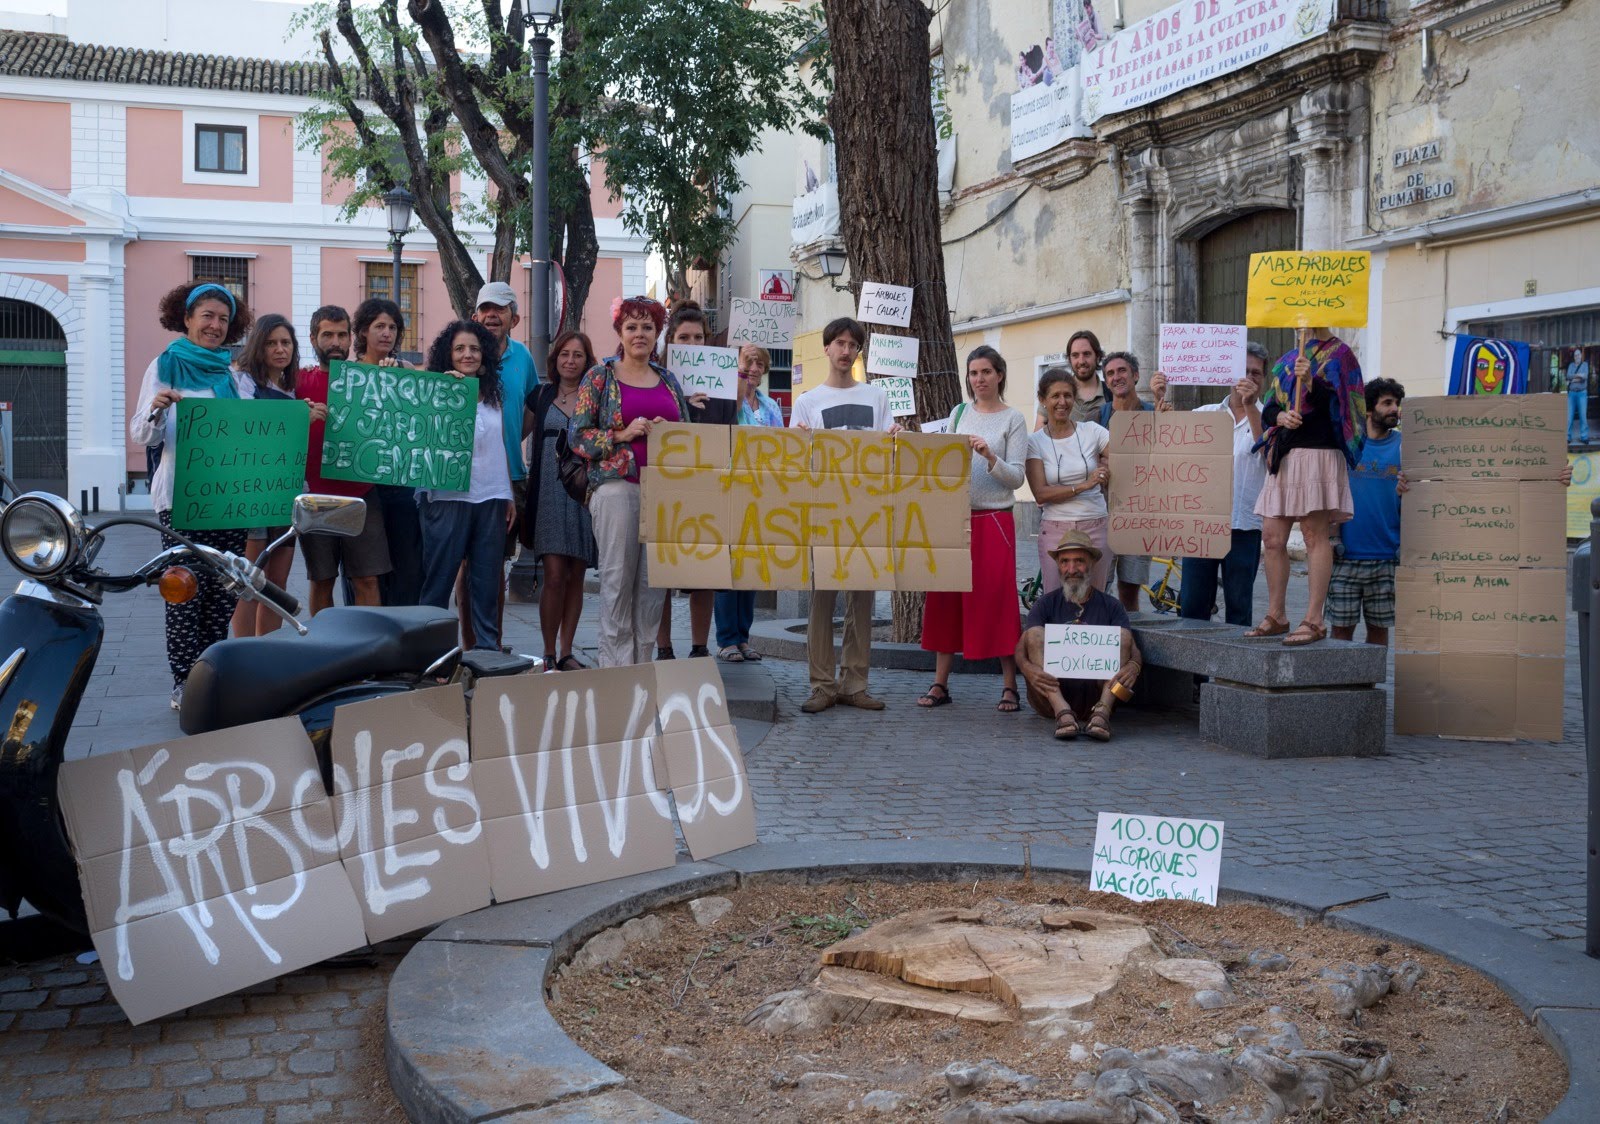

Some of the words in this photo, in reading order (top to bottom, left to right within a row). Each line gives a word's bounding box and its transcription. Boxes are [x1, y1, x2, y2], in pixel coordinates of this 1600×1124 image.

[1086, 72, 1102, 87] EN
[1108, 49, 1162, 81] DEFENSA
[1166, 38, 1182, 56] DE
[1187, 27, 1204, 47] LA
[1209, 1, 1279, 37] CULTURA
[1096, 40, 1119, 69] 17
[1129, 9, 1181, 53] AÑOS
[1194, 0, 1221, 24] DE
[1112, 81, 1128, 97] DE
[1130, 70, 1153, 91] LAS
[1155, 53, 1193, 81] CASAS
[1197, 46, 1214, 63] DE
[1217, 13, 1287, 54] VECINDAD
[1175, 72, 1197, 88] CASA
[1199, 65, 1216, 77] DEL
[1218, 42, 1270, 72] PUMAREJO
[1394, 144, 1438, 166] PLAZA
[1407, 173, 1424, 187] DE
[1379, 182, 1452, 209] PUMAREJO
[1253, 255, 1294, 279] MAS
[1296, 255, 1366, 273] ARBOLES
[1271, 275, 1307, 286] CON
[1311, 273, 1353, 287] HOJAS
[732, 299, 767, 316] PODA
[770, 302, 796, 318] CUTRE
[1283, 295, 1345, 308] COCHES
[748, 318, 778, 329] MATA
[1163, 326, 1187, 336] PARA
[1192, 326, 1205, 334] NO
[1210, 327, 1239, 335] TALAR
[733, 324, 789, 344] ÁRBOLES
[1163, 341, 1178, 350] HAY
[1182, 340, 1197, 349] QUE
[1201, 340, 1239, 348] CUIDAR
[671, 349, 705, 366] MALA
[709, 352, 739, 370] PODA
[1162, 354, 1174, 362] LOS
[682, 374, 724, 389] MATA
[888, 378, 912, 388] PODA
[245, 420, 287, 437] UNA
[329, 405, 351, 433] Y
[357, 408, 475, 447] JARDINES
[1121, 413, 1214, 447] ÁRBOLES
[321, 440, 355, 468] DE
[656, 430, 714, 479] EL
[1490, 445, 1506, 453] UN
[1511, 440, 1548, 453] ÁRBOL
[1433, 458, 1472, 468] ANTES
[1477, 458, 1495, 467] DE
[1135, 461, 1209, 487] BANCOS
[1471, 470, 1501, 478] OTRO
[186, 502, 210, 522] DE
[1492, 505, 1512, 515] EN
[1111, 516, 1184, 532] QUEREMOS
[1193, 519, 1231, 536] PLAZAS
[656, 501, 723, 566] NOS
[730, 500, 937, 586] ASFIXIA
[1471, 611, 1496, 621] CON
[114, 729, 483, 981] ÁRBOLES
[499, 681, 746, 873] VIVOS
[1110, 817, 1219, 852] 10.000
[1095, 845, 1197, 878] ALCORQUES
[1095, 870, 1160, 898] VACÍOS
